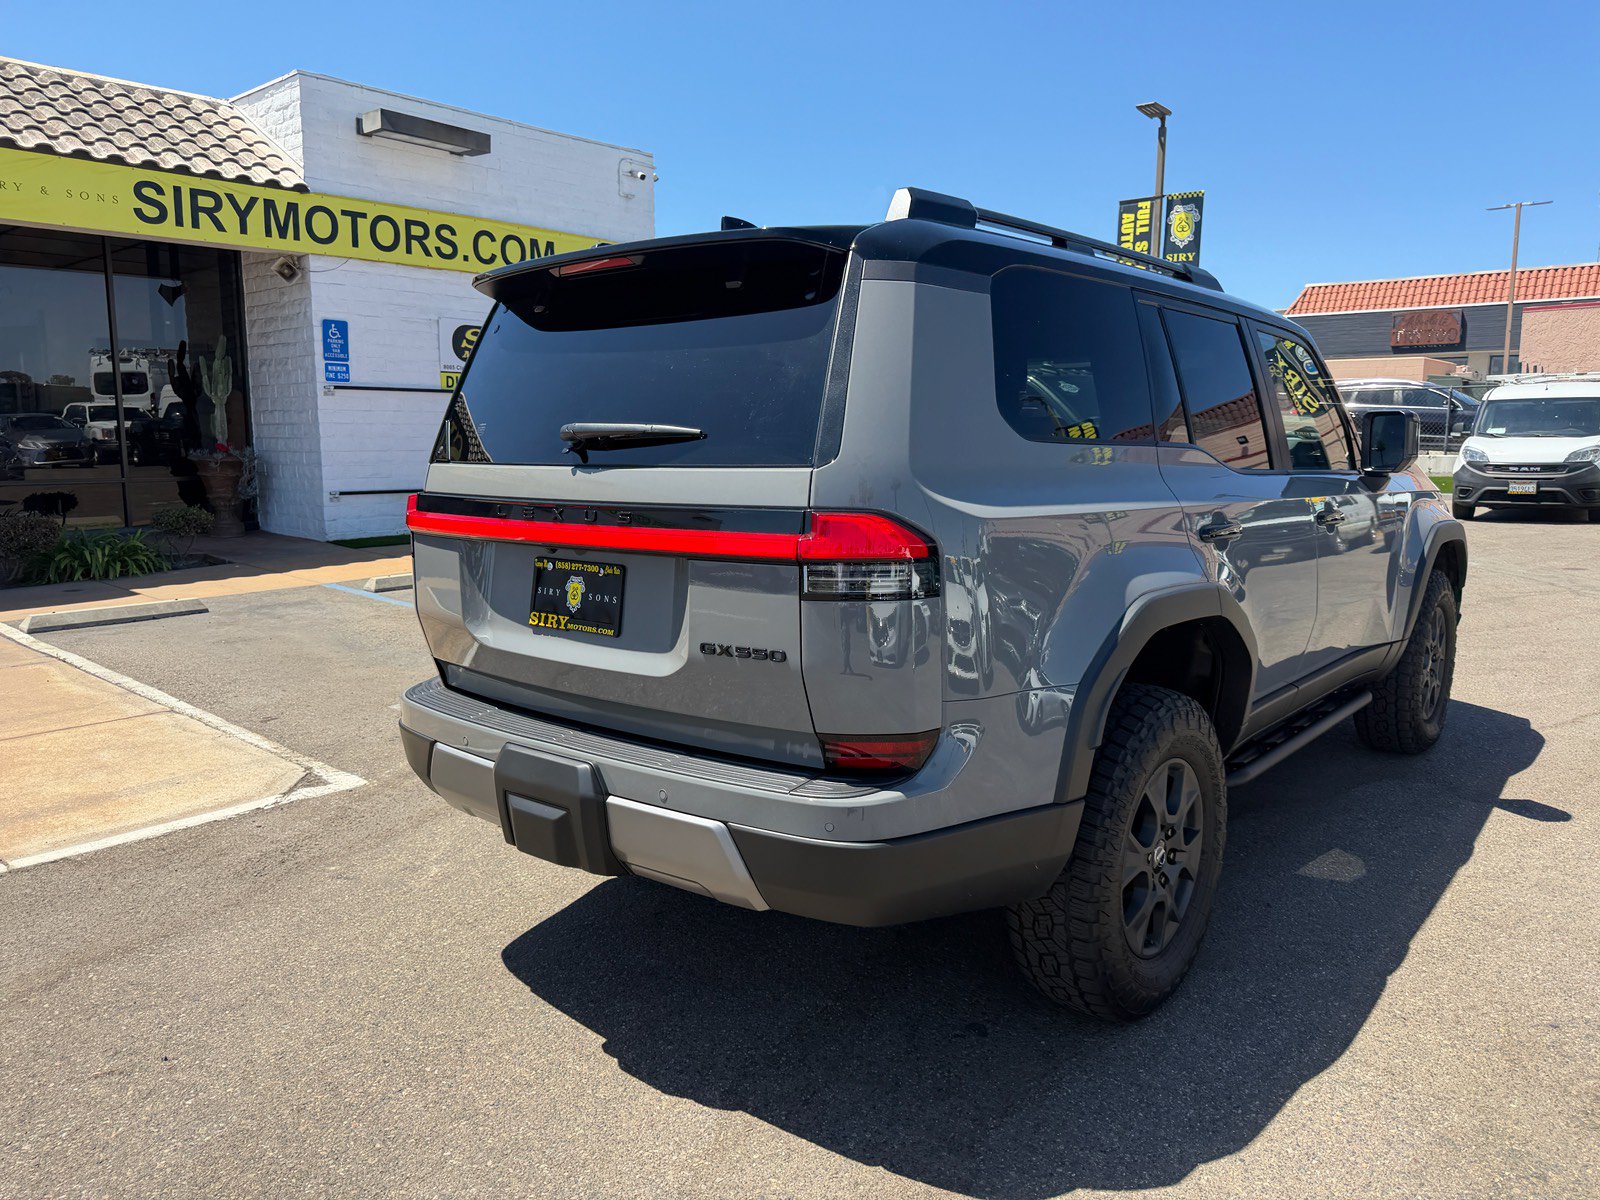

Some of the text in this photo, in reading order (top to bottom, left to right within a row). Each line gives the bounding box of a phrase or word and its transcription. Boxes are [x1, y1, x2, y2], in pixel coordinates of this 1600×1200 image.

[40, 185, 49, 196] &
[66, 189, 119, 205] SONS
[132, 180, 556, 266] SIRYMOTORS.COM
[1136, 201, 1151, 236] FULL
[1166, 252, 1195, 262] SIRY
[497, 504, 632, 524] LEXUS
[555, 560, 571, 570] (858)
[571, 563, 599, 573] 277-7300
[537, 587, 618, 604] SIRY SONS
[699, 642, 788, 663] GX550
